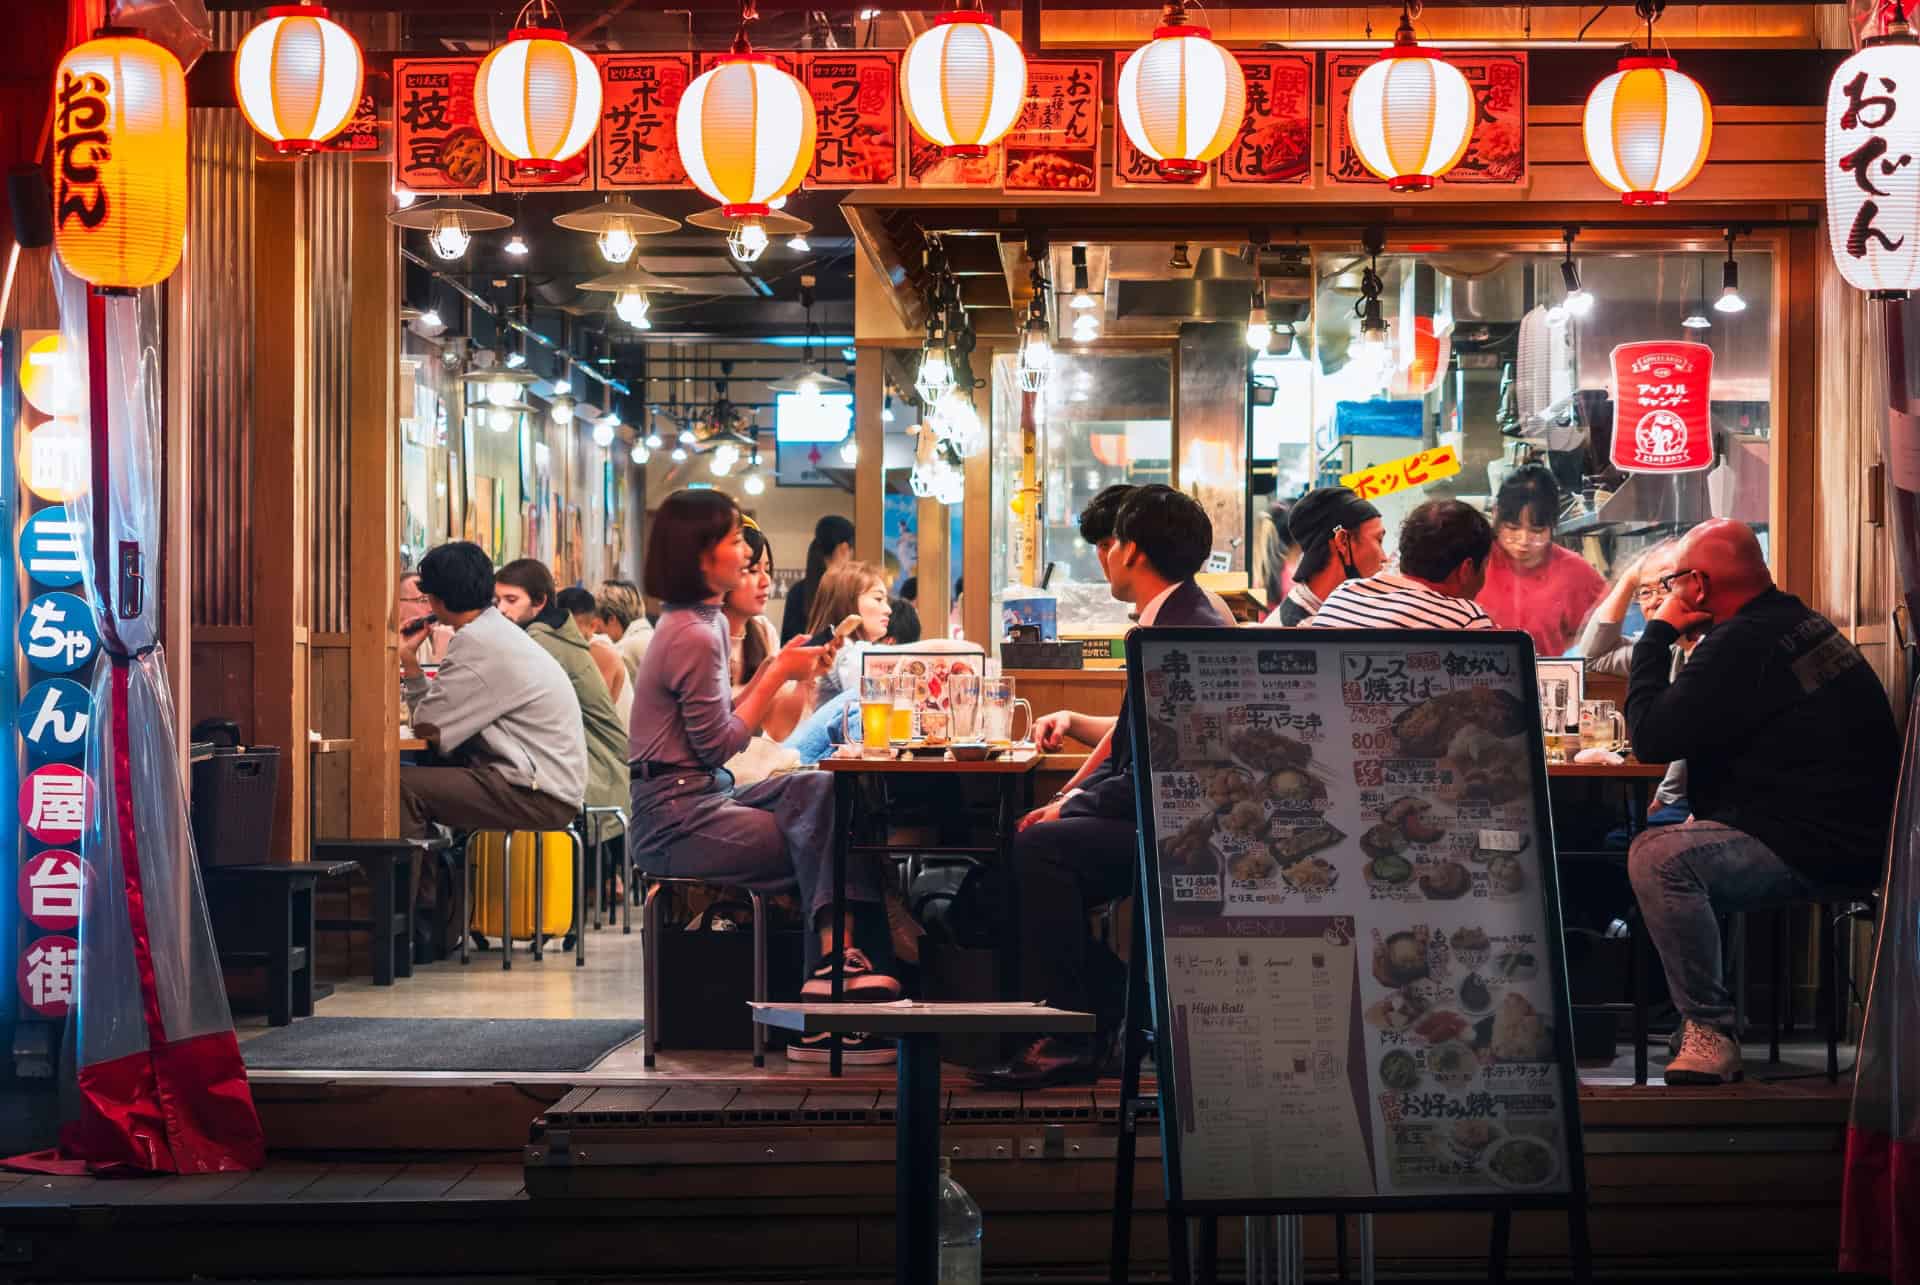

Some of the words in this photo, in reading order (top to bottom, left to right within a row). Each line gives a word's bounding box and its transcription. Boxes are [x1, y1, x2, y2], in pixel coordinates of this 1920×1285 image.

[57, 70, 111, 230] おでん
[401, 90, 452, 172] 枝豆
[604, 105, 637, 176] サラダ
[632, 79, 663, 164] ポテト
[831, 80, 864, 168] フライド
[1839, 72, 1911, 259] おでん
[1637, 384, 1688, 395] アップル
[1637, 396, 1690, 406] キャンデー
[1354, 454, 1450, 501] ホッピー
[1348, 656, 1408, 680] ソース
[1192, 1001, 1218, 1016] High
